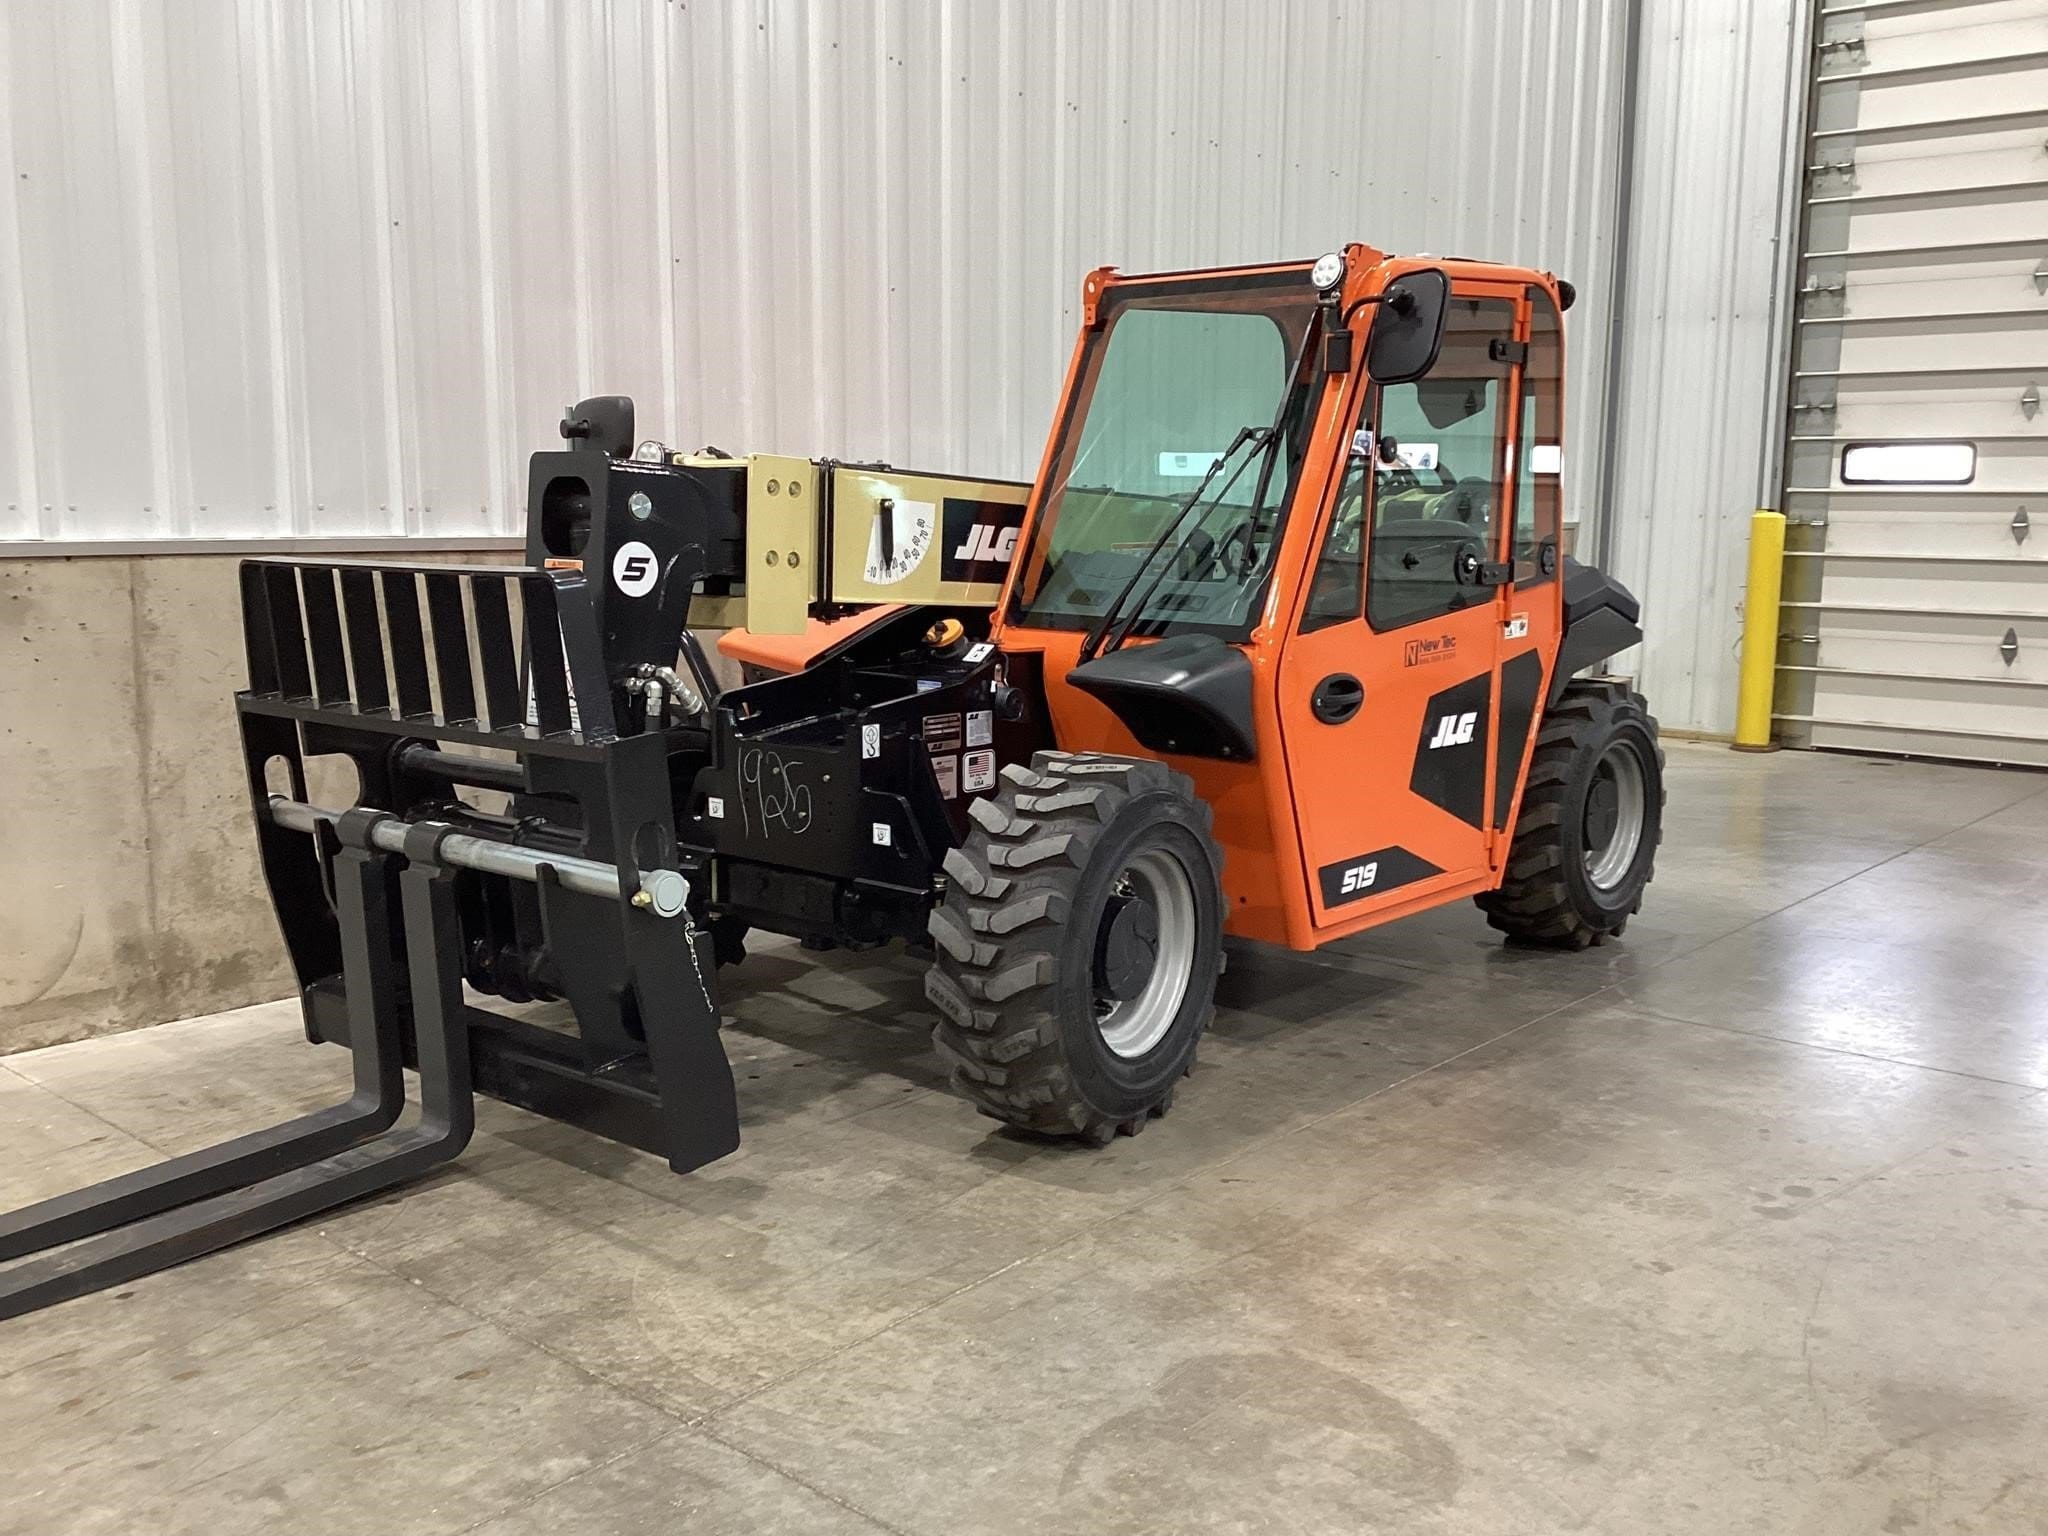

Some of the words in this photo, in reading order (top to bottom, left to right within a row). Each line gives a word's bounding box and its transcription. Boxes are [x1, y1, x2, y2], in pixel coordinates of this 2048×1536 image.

[916, 519, 926, 528] 80
[912, 536, 920, 546] 60
[920, 530, 928, 540] 70
[954, 524, 1023, 562] JLG
[621, 557, 651, 581] 5
[1420, 640, 1440, 652] New
[1441, 635, 1456, 648] Tec
[1429, 712, 1477, 749] JLG
[1341, 862, 1378, 894] 519
